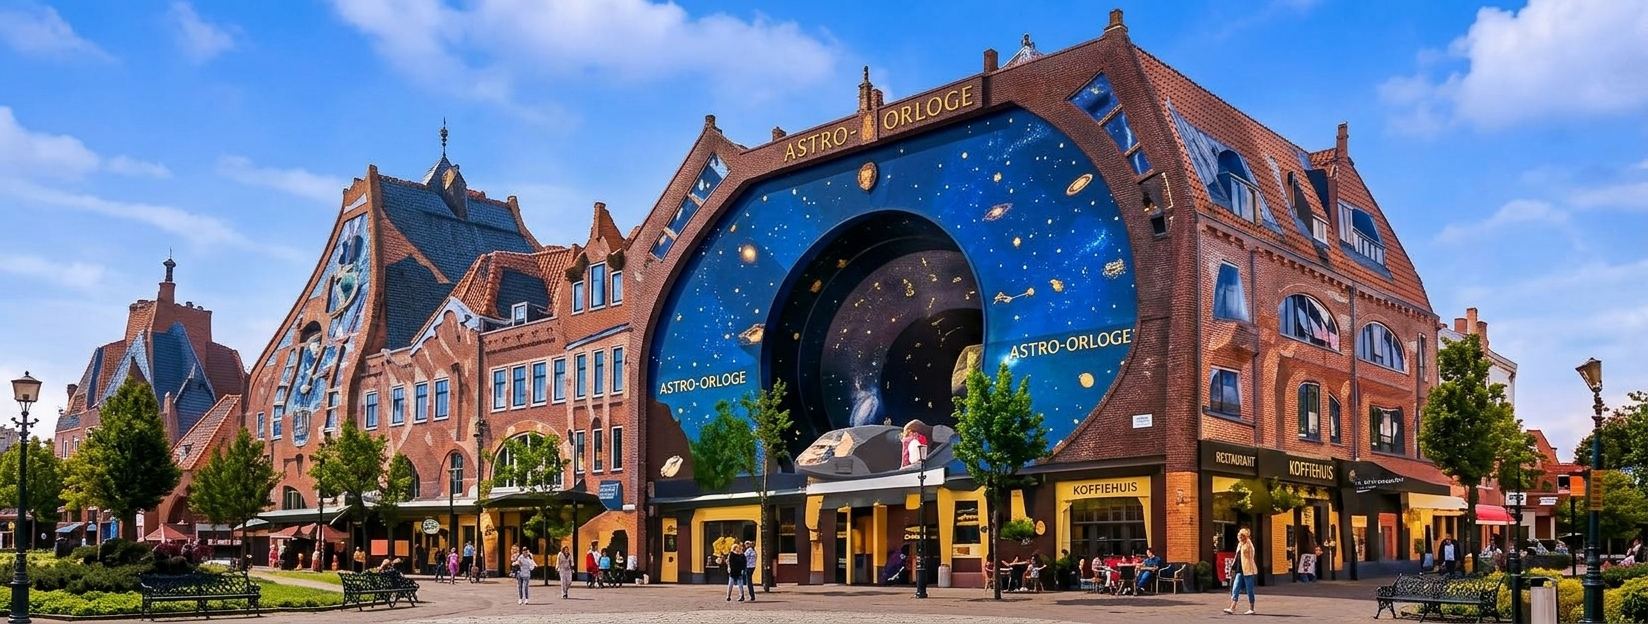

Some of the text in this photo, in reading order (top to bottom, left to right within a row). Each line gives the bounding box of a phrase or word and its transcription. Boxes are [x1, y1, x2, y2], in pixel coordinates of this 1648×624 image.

[783, 85, 974, 162] ASTRO- ORLOGE
[659, 370, 747, 395] ASTRO-ORLOGE
[1289, 460, 1334, 480] KOFFIEHUIS
[1073, 482, 1138, 495] KOFFIEHUIS
